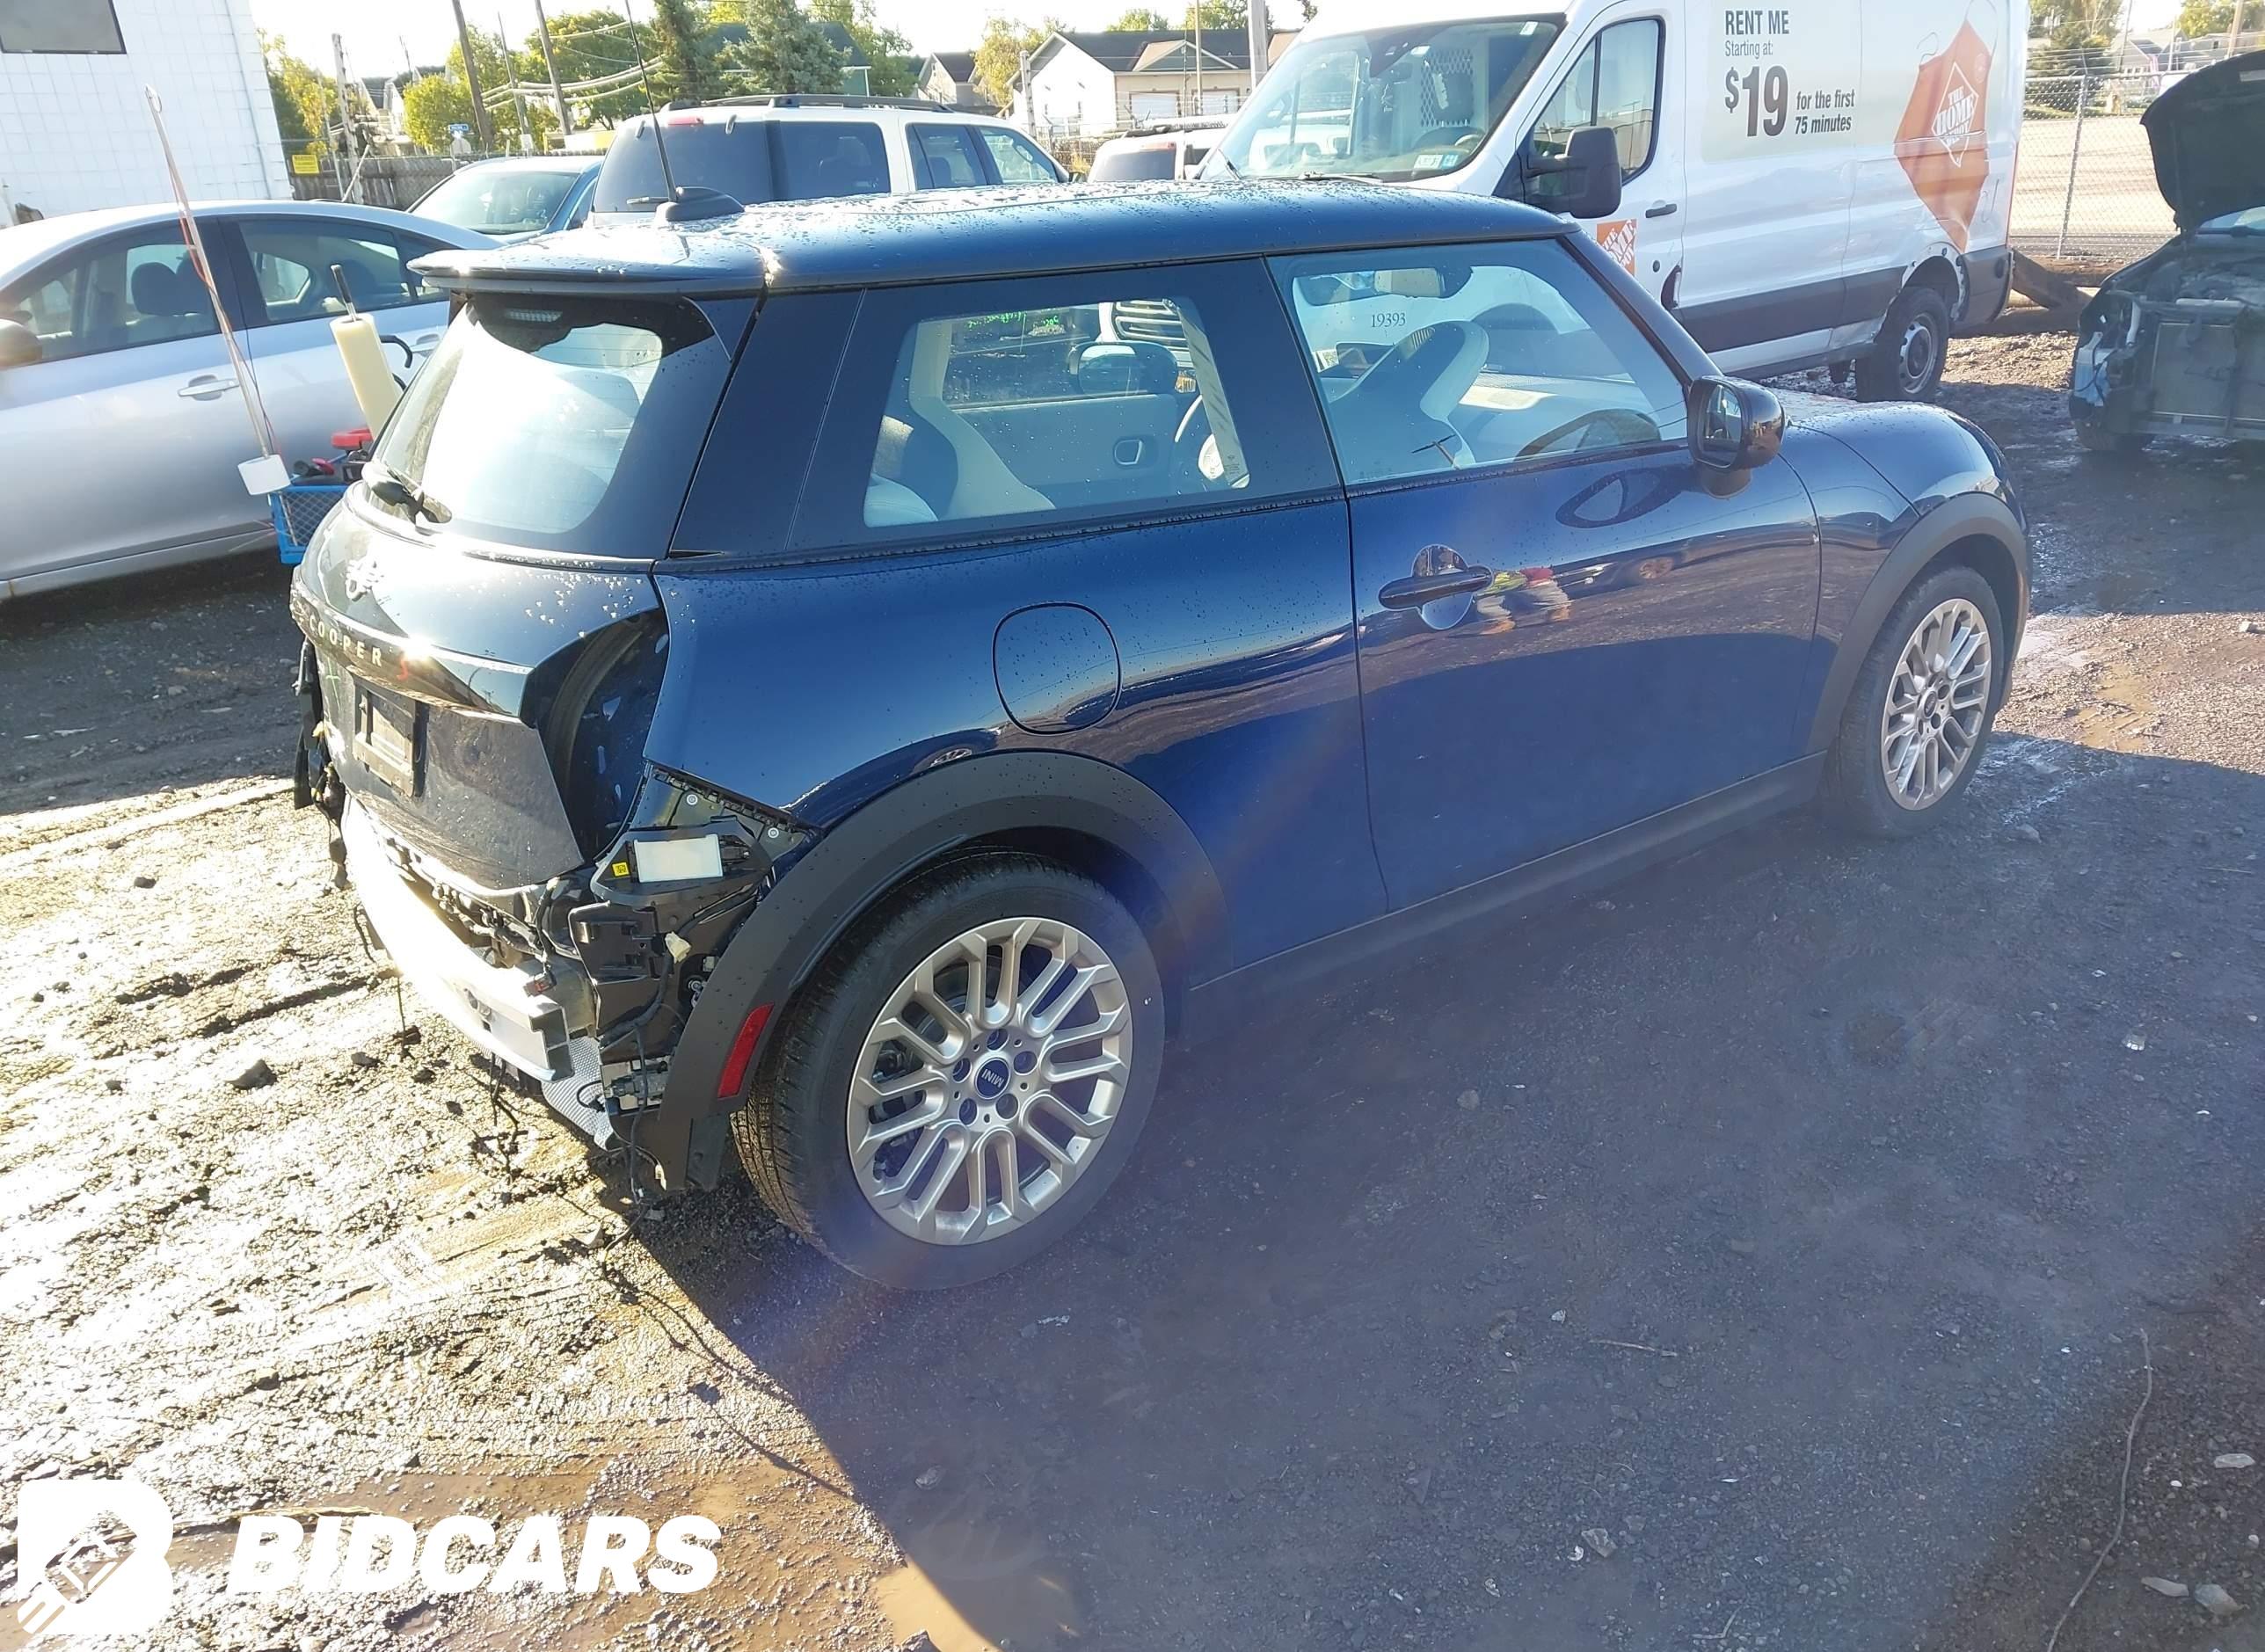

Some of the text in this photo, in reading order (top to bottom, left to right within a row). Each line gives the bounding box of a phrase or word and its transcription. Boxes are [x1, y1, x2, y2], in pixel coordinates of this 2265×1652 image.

[1725, 10, 1789, 35] RENT ME
[1725, 40, 1773, 60] Starting at:
[1724, 65, 1788, 137] $19
[1796, 89, 1855, 110] for the first
[1795, 113, 1852, 135] 75 minutes
[1936, 93, 1974, 135] HOME
[1372, 312, 1406, 328] 19393
[310, 615, 382, 667] COOPER
[981, 1068, 1004, 1088] MINI
